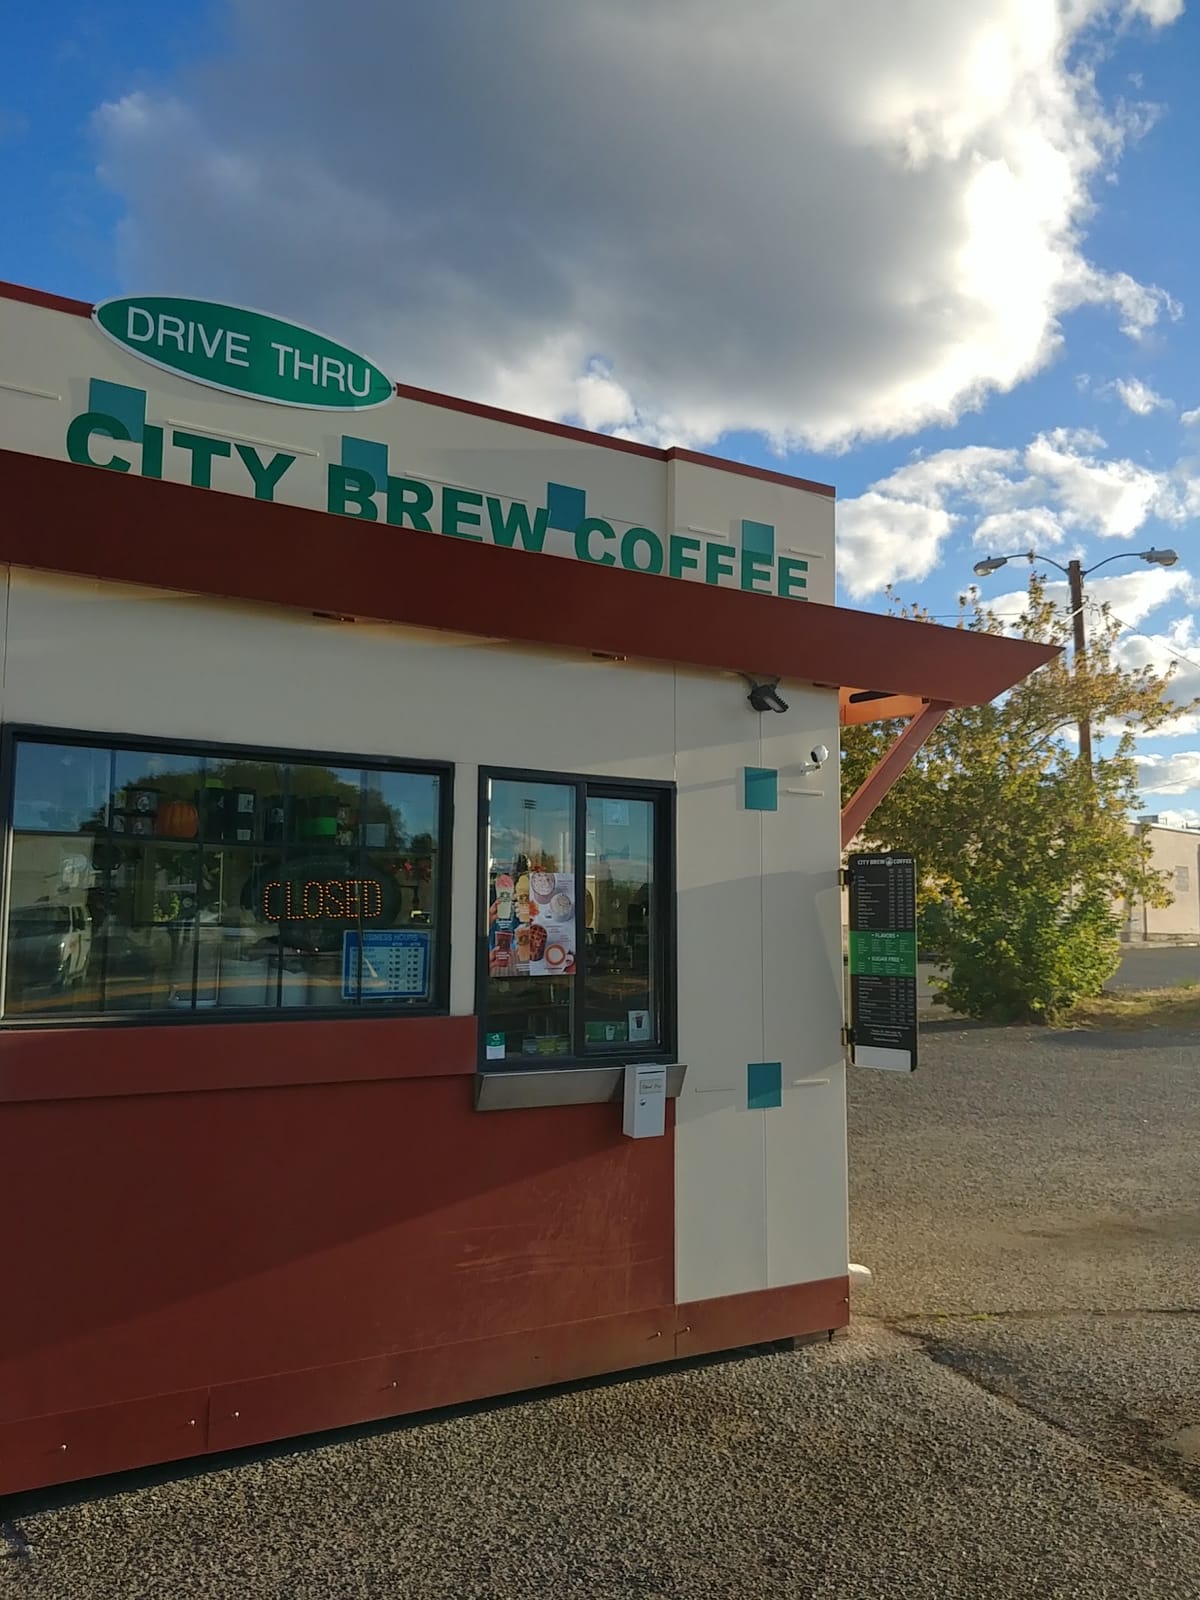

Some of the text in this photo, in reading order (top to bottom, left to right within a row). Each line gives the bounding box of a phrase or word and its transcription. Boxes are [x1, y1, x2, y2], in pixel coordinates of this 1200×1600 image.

[127, 306, 371, 397] DRIVE THRU
[66, 412, 808, 600] CITY BREW COFFEE
[264, 880, 381, 920] CLOSED
